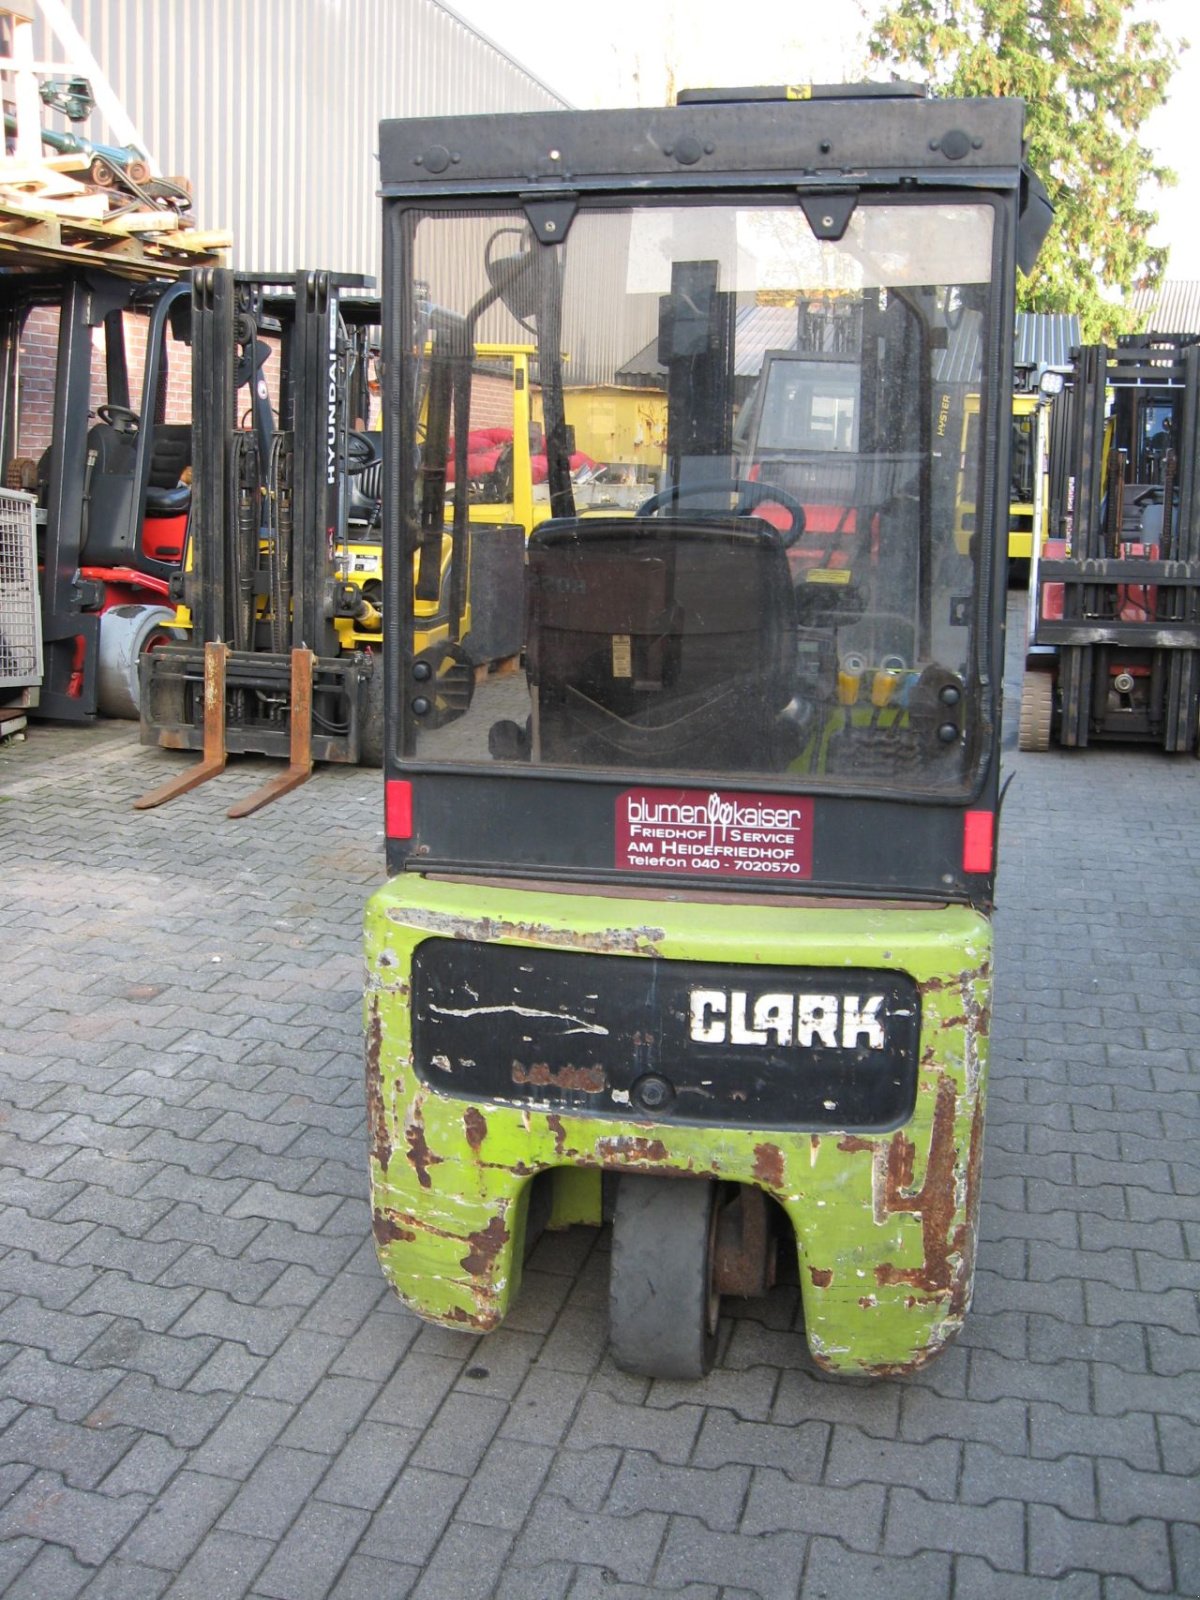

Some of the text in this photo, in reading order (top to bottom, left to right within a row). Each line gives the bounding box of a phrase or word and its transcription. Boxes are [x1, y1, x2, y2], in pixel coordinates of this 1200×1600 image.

[327, 353, 337, 485] HYUNDAI
[937, 394, 951, 437] HYSTER
[628, 796, 801, 828] blumen kaiser
[627, 841, 795, 860] AM HEIDEFRIEDHOF
[630, 825, 795, 844] FRIEDHOF SERVICE
[627, 855, 687, 868] Telefon
[691, 859, 720, 869] 040
[734, 861, 801, 873] 7020570
[689, 989, 885, 1050] CLARK
